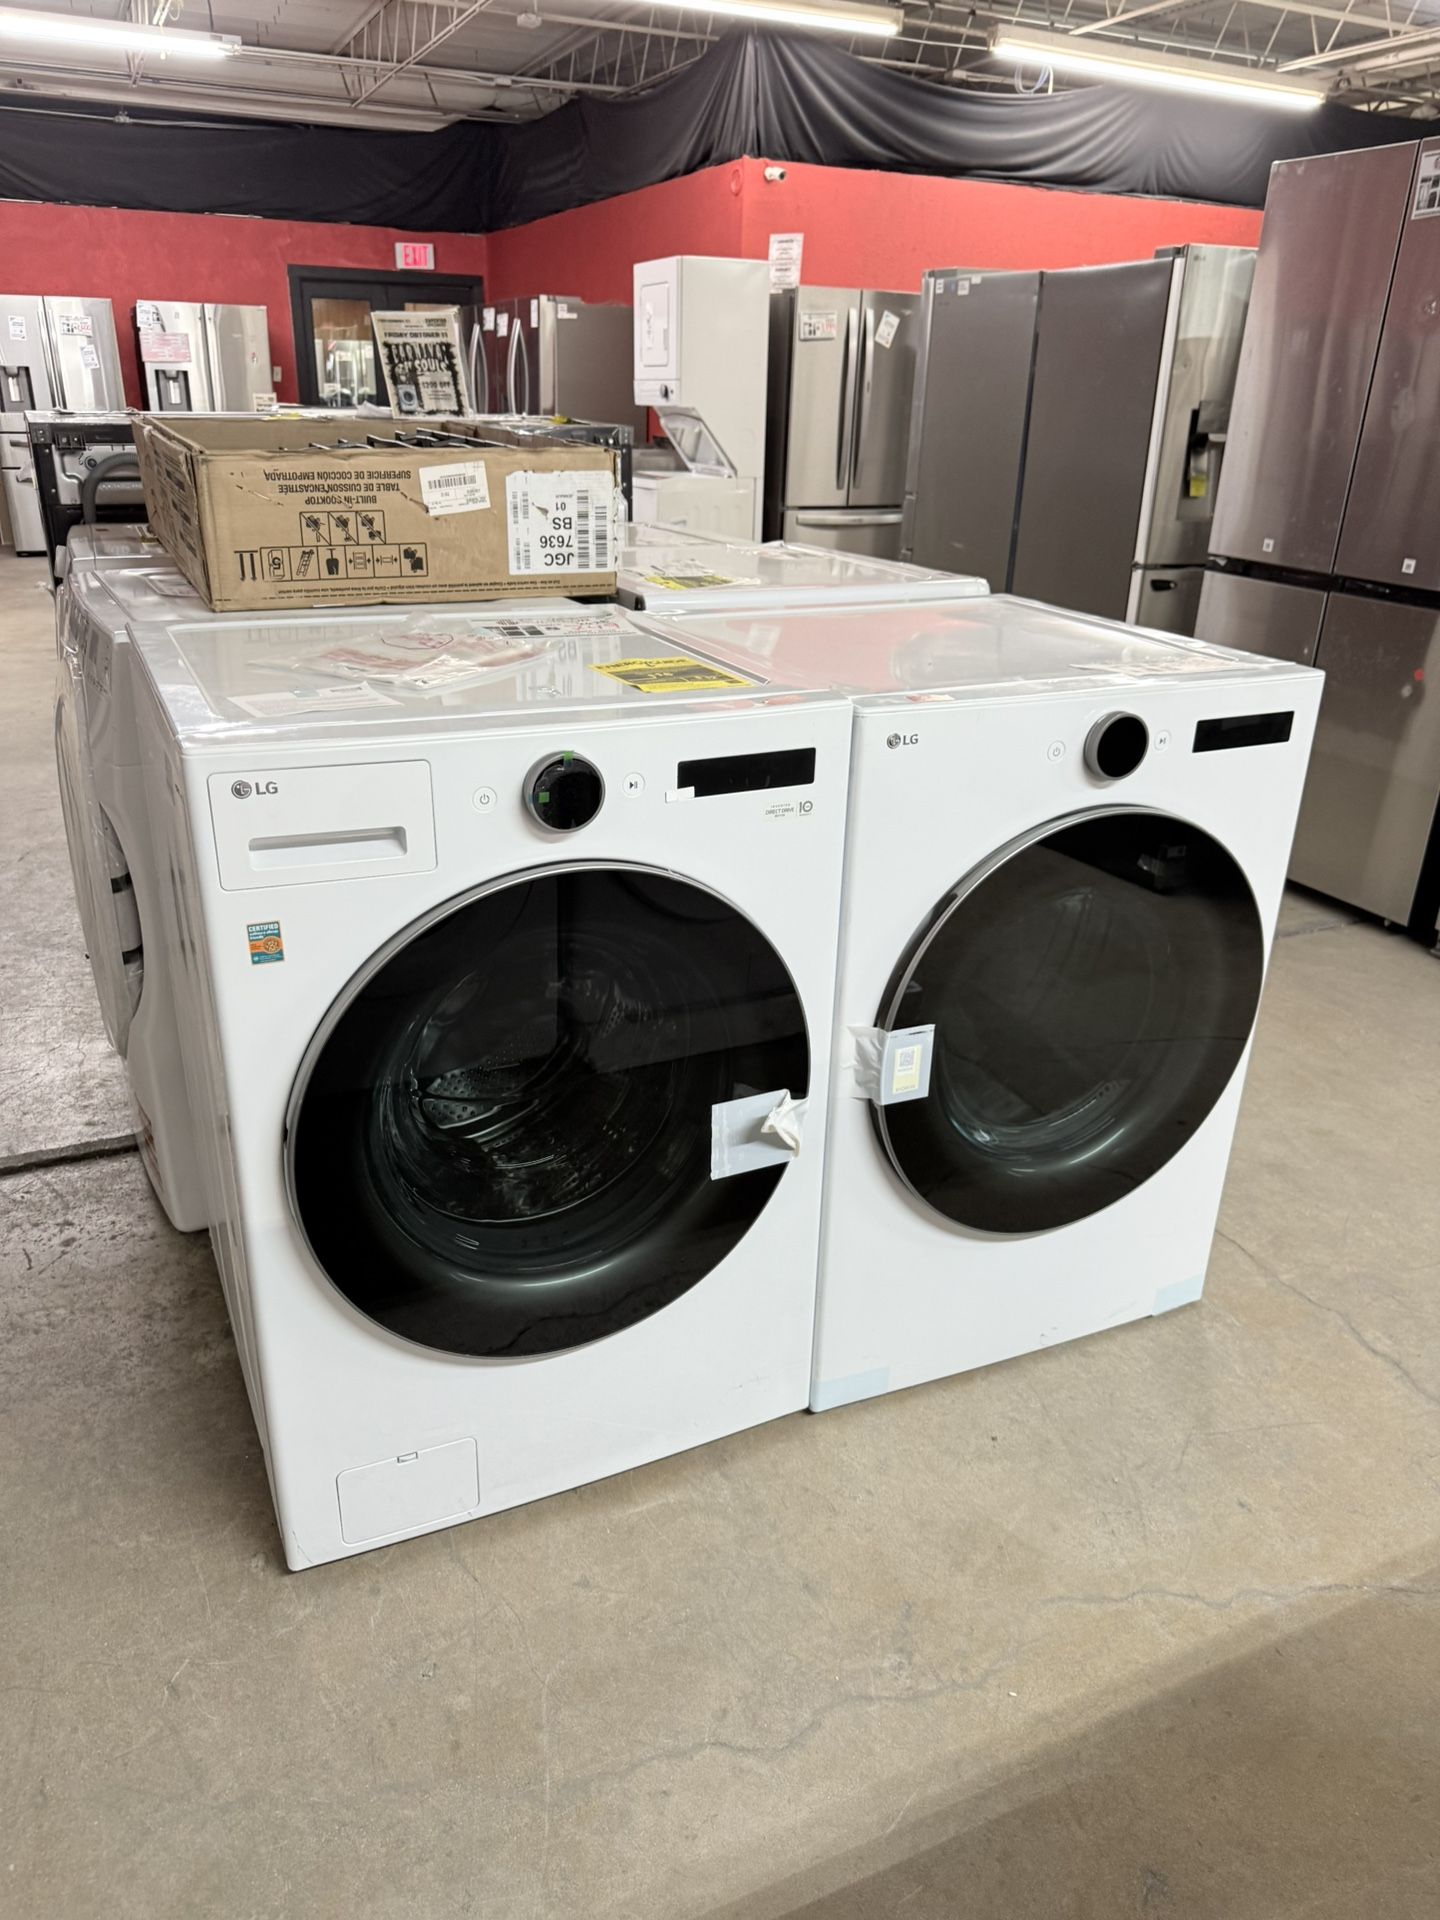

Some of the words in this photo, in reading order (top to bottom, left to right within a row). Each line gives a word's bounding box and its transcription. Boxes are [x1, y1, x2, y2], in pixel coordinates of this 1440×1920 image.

[403, 245, 428, 267] EXIT
[264, 471, 315, 482] EMPOTRADA
[316, 470, 352, 482] COCCIÓN
[354, 470, 365, 480] DE
[367, 470, 412, 480] SUPERFICIE
[278, 483, 328, 496] ENCASTRÉE
[329, 483, 362, 492] CUISSON
[363, 483, 374, 492] DE
[376, 483, 401, 492] TABLE
[344, 495, 377, 505] BUILT-IN
[555, 502, 566, 511] 01
[552, 517, 572, 531] BS
[539, 535, 573, 549] 7636
[544, 552, 575, 567] JGC
[248, 923, 279, 932] CERTIFIED
